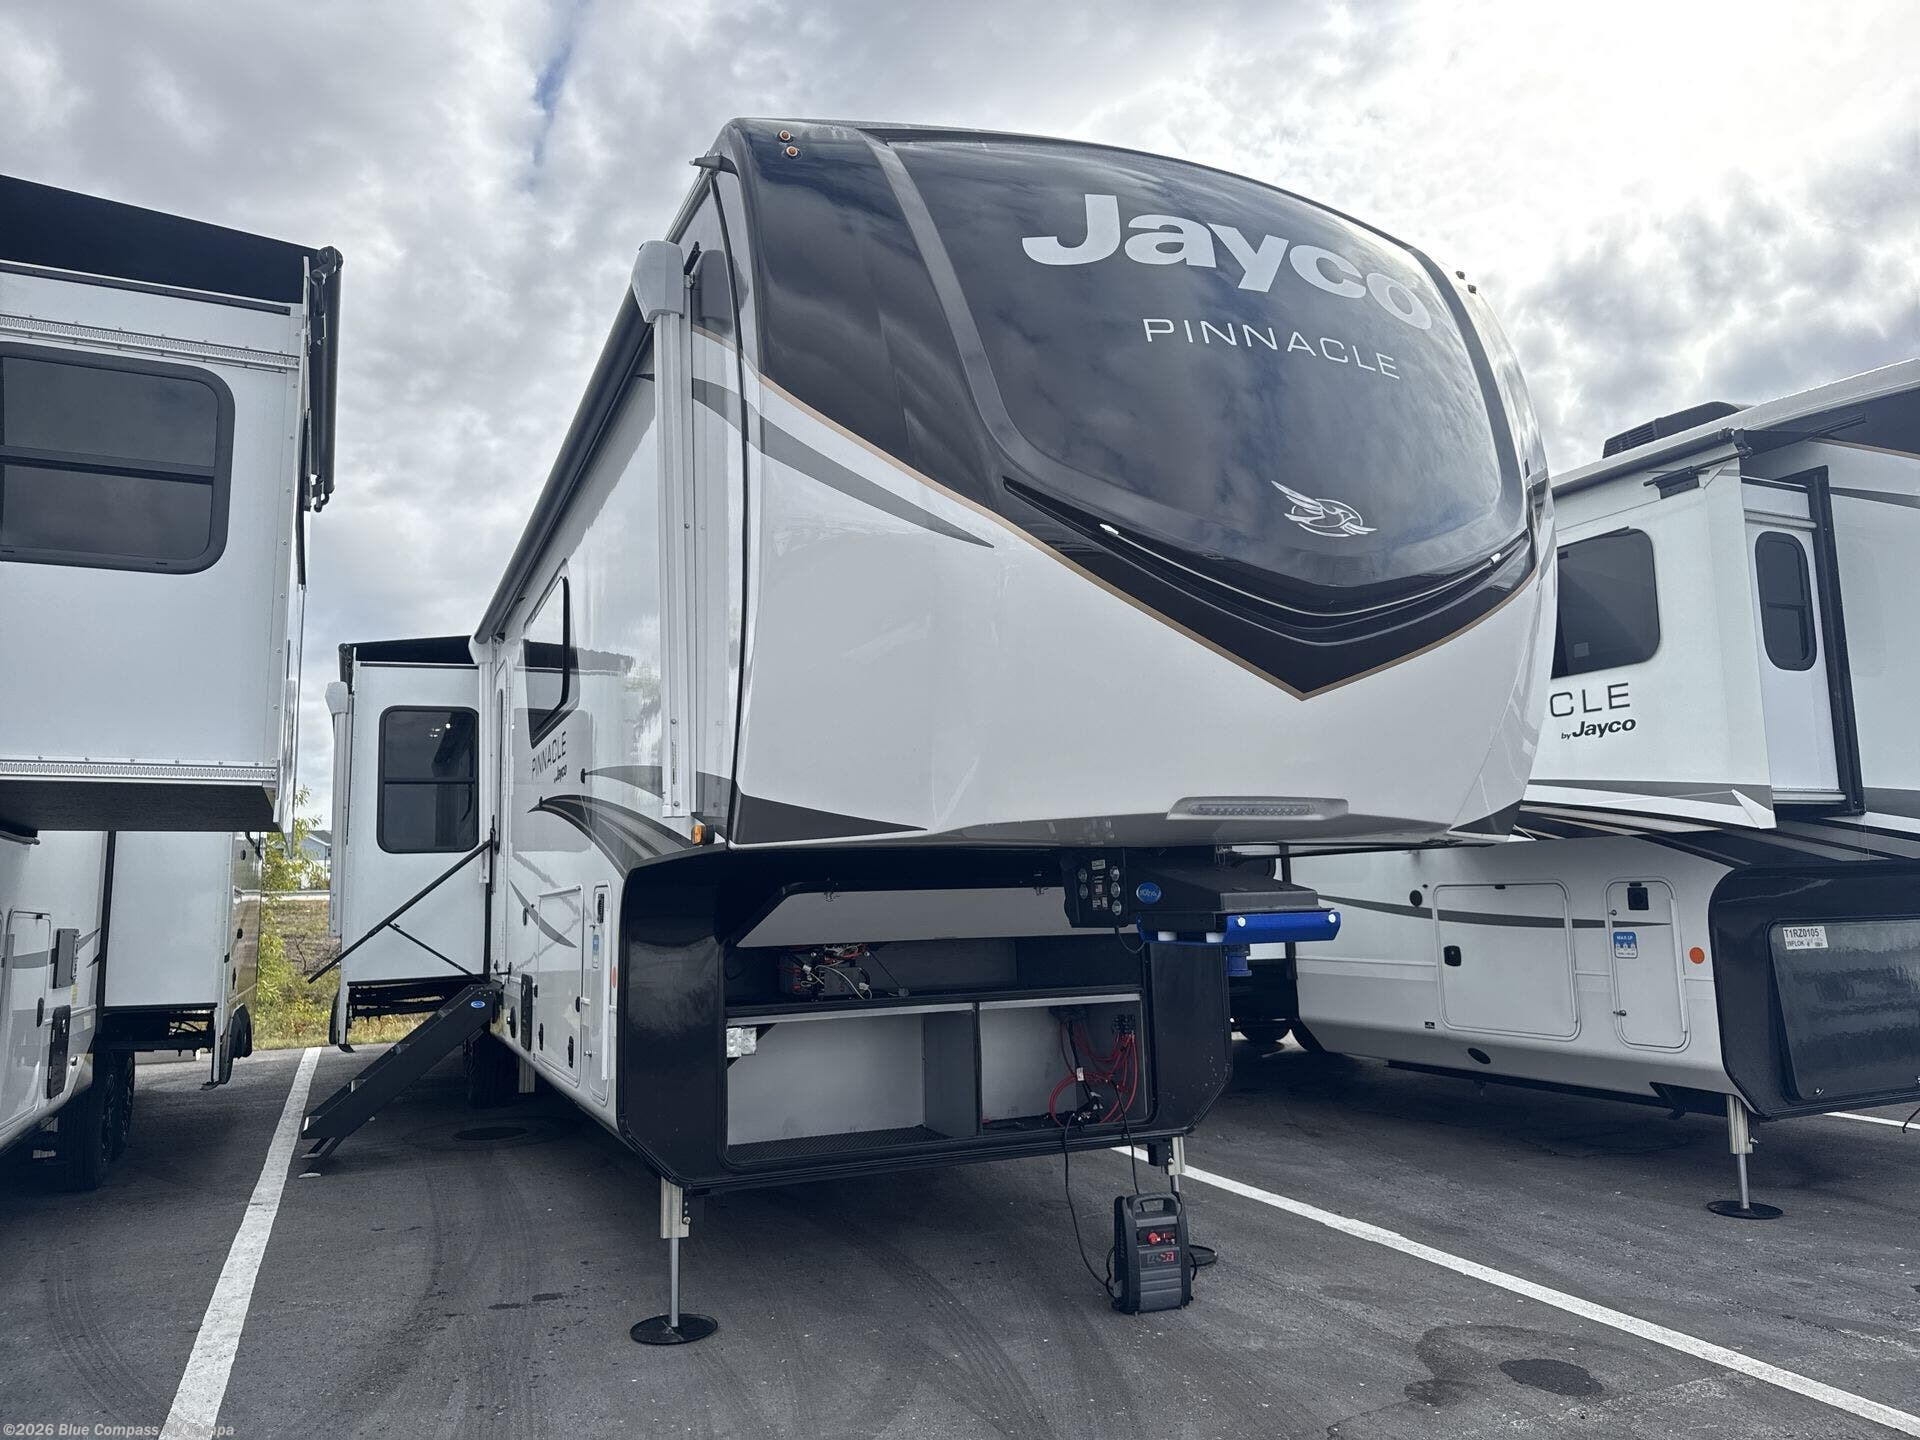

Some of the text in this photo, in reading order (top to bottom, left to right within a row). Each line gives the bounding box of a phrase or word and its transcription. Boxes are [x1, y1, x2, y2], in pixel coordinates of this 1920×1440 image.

[1022, 194, 1431, 330] Jayco
[1143, 319, 1400, 379] PINNACLE
[1550, 682, 1630, 717] CLE
[1572, 719, 1636, 738] Jayco
[532, 731, 566, 779] PINNACLE
[1784, 928, 1819, 938] T1RZ0105
